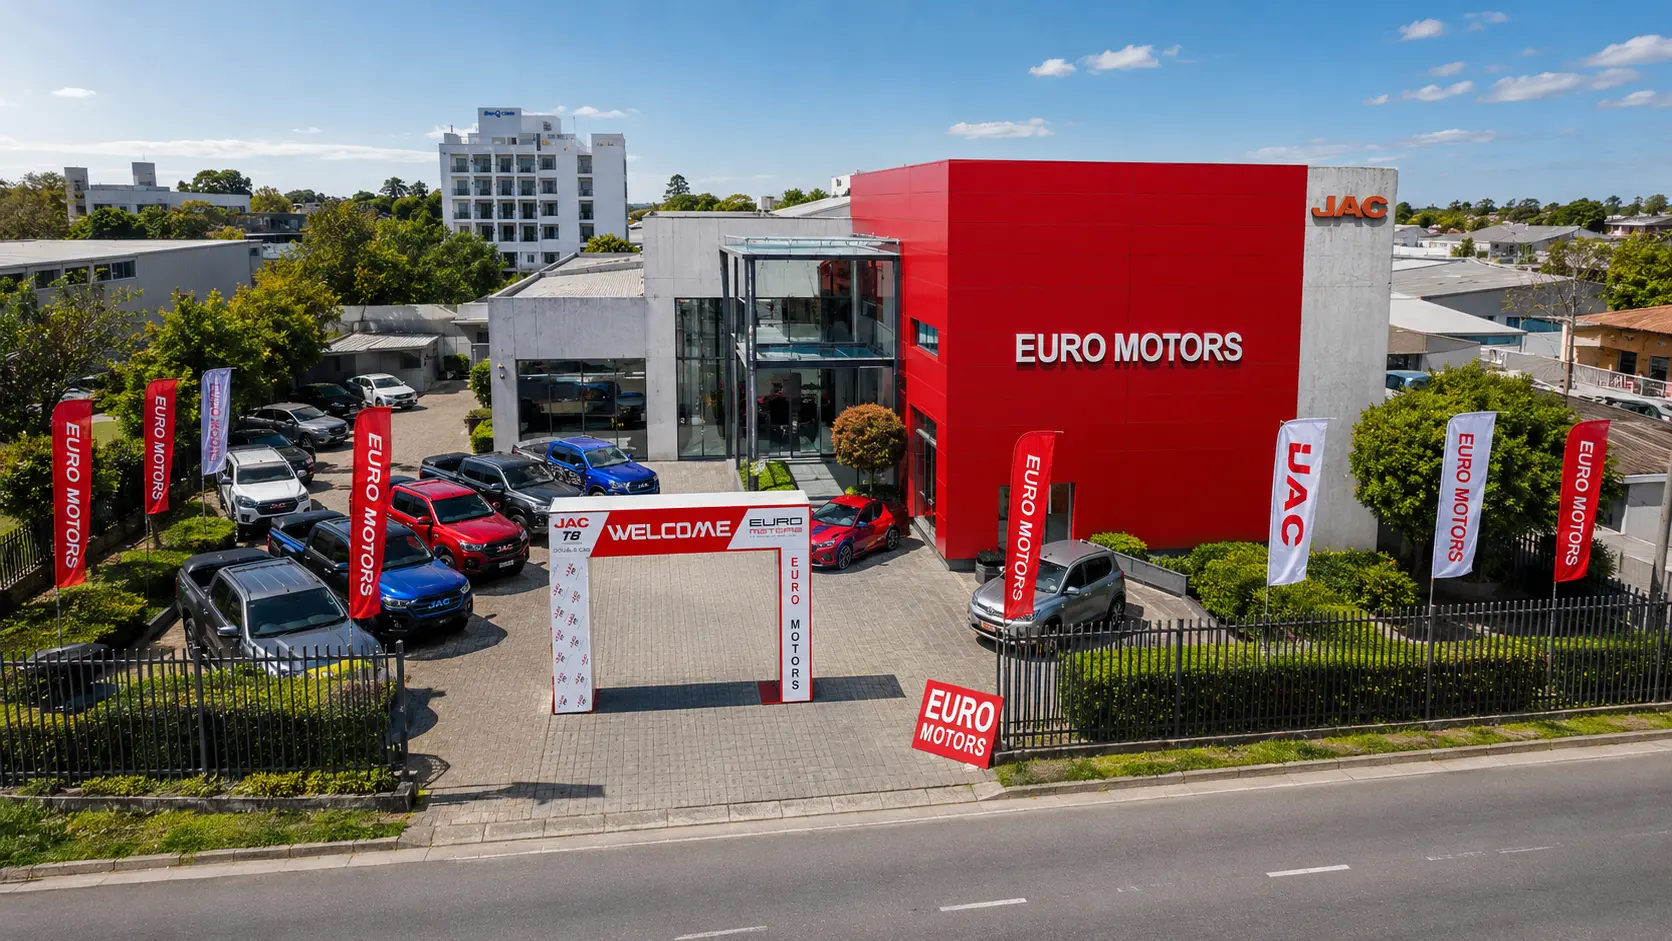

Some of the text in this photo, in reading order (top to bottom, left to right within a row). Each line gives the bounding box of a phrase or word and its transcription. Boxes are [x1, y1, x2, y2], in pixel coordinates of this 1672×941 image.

[1311, 195, 1388, 219] JAC
[1015, 332, 1243, 363] EURO MOTORS
[153, 395, 166, 500] EURO MOTORS
[66, 421, 80, 568] EURO MOTORS
[360, 432, 383, 596] EURO MOTORS
[553, 517, 589, 529] JAC
[606, 520, 732, 541] WELCOME
[749, 517, 803, 527] EURO
[1012, 453, 1041, 601] EURO MOTORS
[1448, 433, 1475, 563] EURO MOTORS
[1565, 441, 1594, 566] EURO MOTORS
[791, 557, 800, 690] EURO MOTORS
[919, 722, 987, 757] MOTORS
[924, 688, 995, 733] EURO
